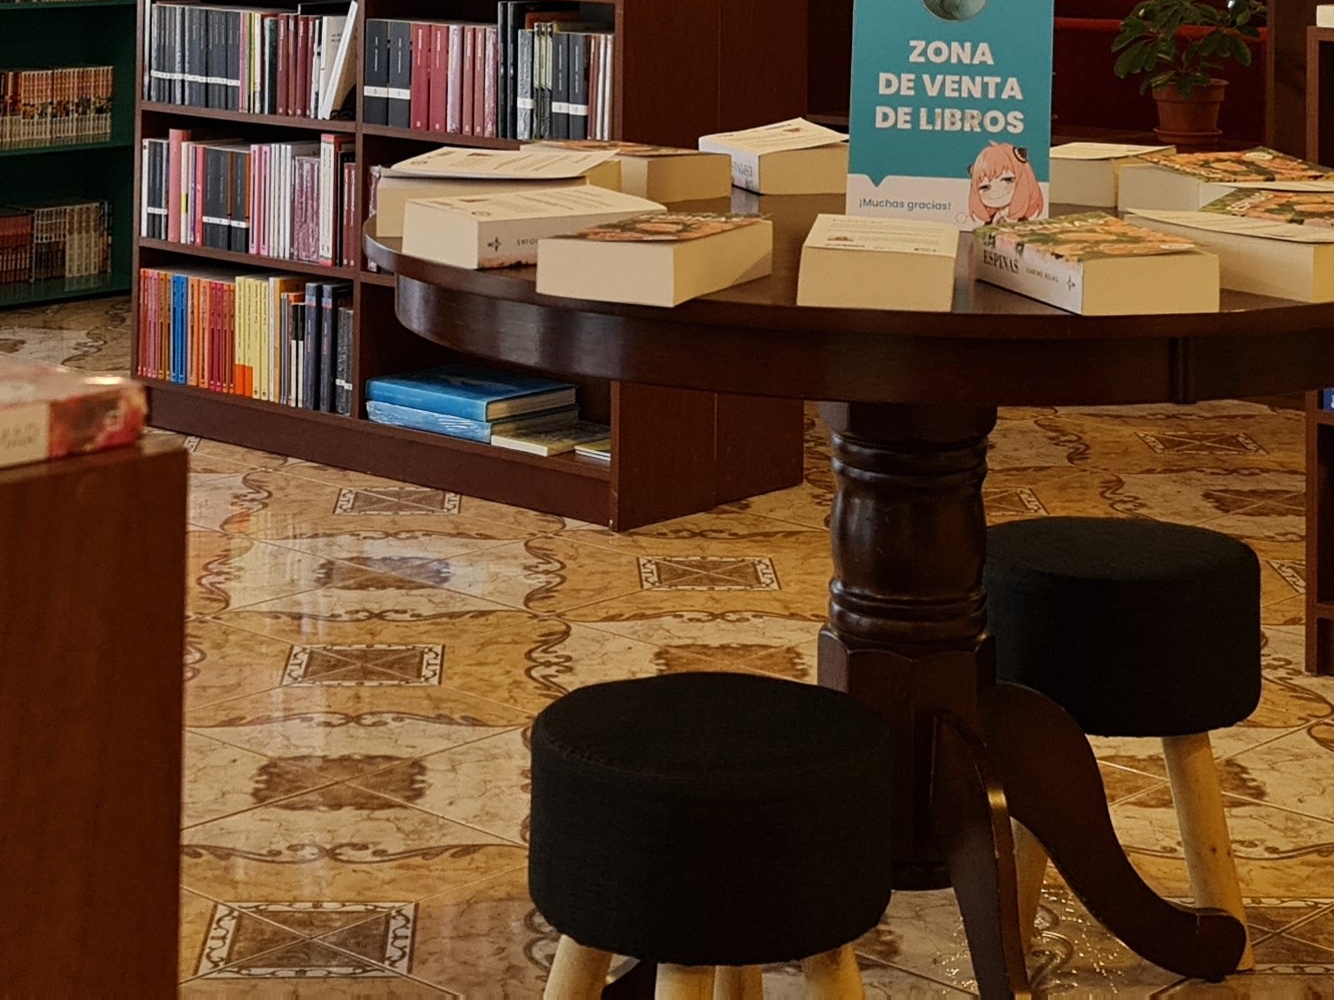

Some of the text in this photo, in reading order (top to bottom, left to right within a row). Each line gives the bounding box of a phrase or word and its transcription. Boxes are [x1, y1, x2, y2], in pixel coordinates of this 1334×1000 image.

[908, 39, 994, 65] ZONA
[878, 72, 1024, 100] DE VENTA
[875, 106, 1025, 134] DE LIBROS
[859, 198, 951, 212] ¡Muchas gracias!
[983, 248, 1020, 275] ESPINAS
